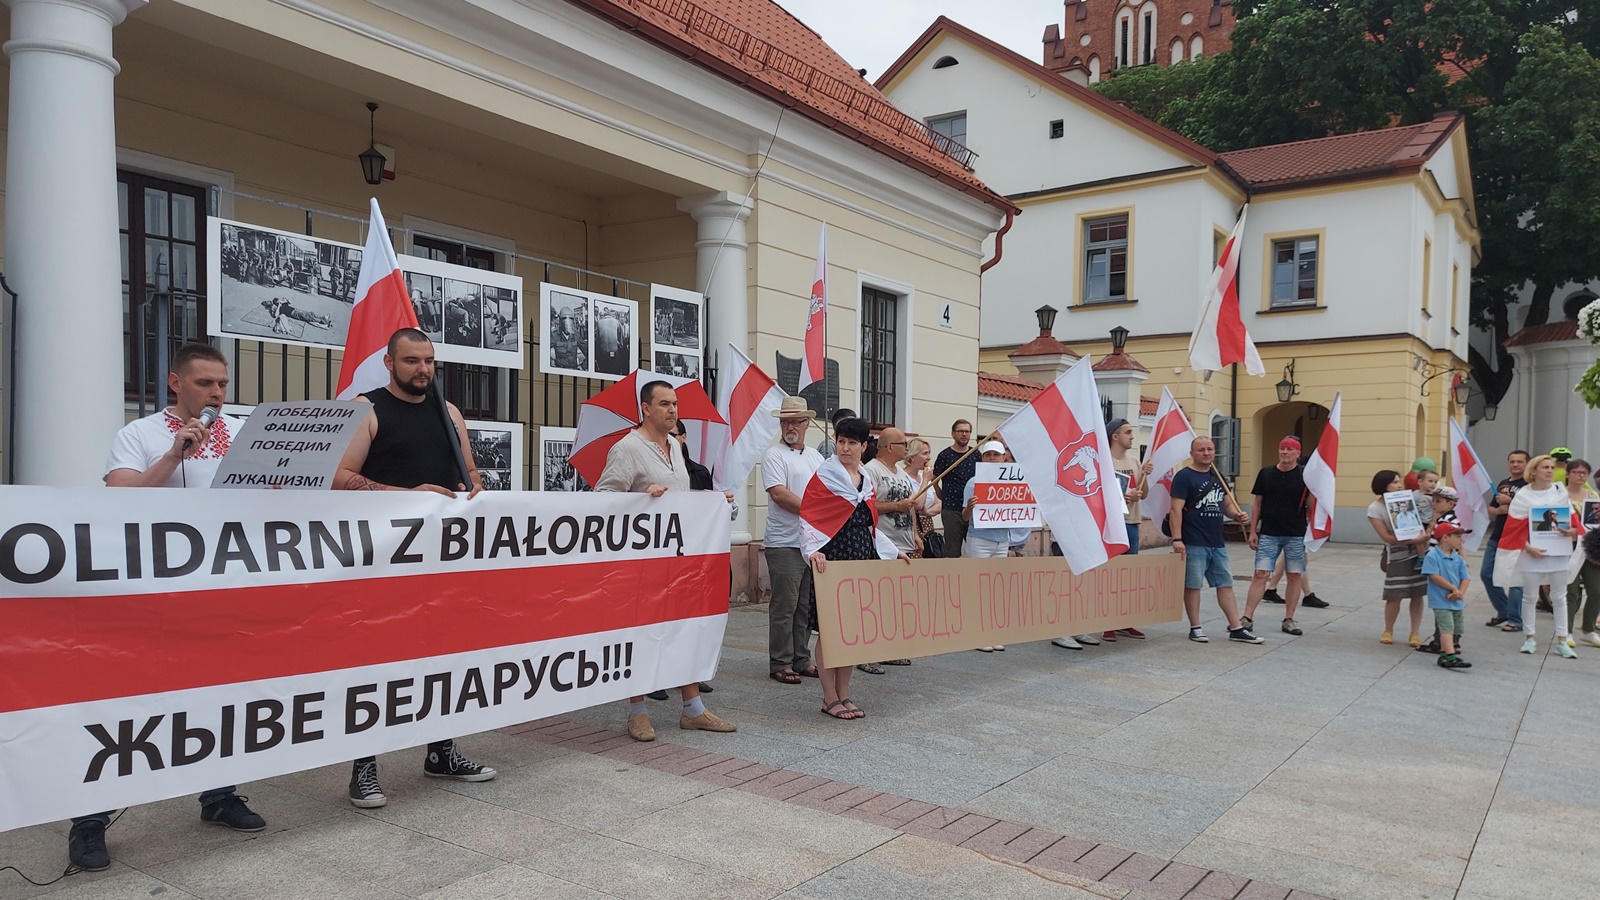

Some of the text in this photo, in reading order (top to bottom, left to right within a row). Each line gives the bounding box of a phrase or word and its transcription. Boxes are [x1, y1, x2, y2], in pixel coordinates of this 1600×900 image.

[942, 304, 950, 323] 4
[266, 407, 355, 418] ПОБЕДИЛИ
[264, 422, 344, 433] ФАШИЗМ!
[250, 440, 331, 453] ПОБЕДИМ
[277, 457, 290, 467] И
[223, 473, 324, 487] ЛУКАШИЗМ!
[987, 485, 1035, 501] DOBREM
[0, 513, 684, 584] OLIDARNI Z BIAŁORUSIĄ
[836, 574, 962, 646] СВОБОДУ
[83, 642, 633, 783] ЖЫВЕ БЕЛАРУСЬ!!!
